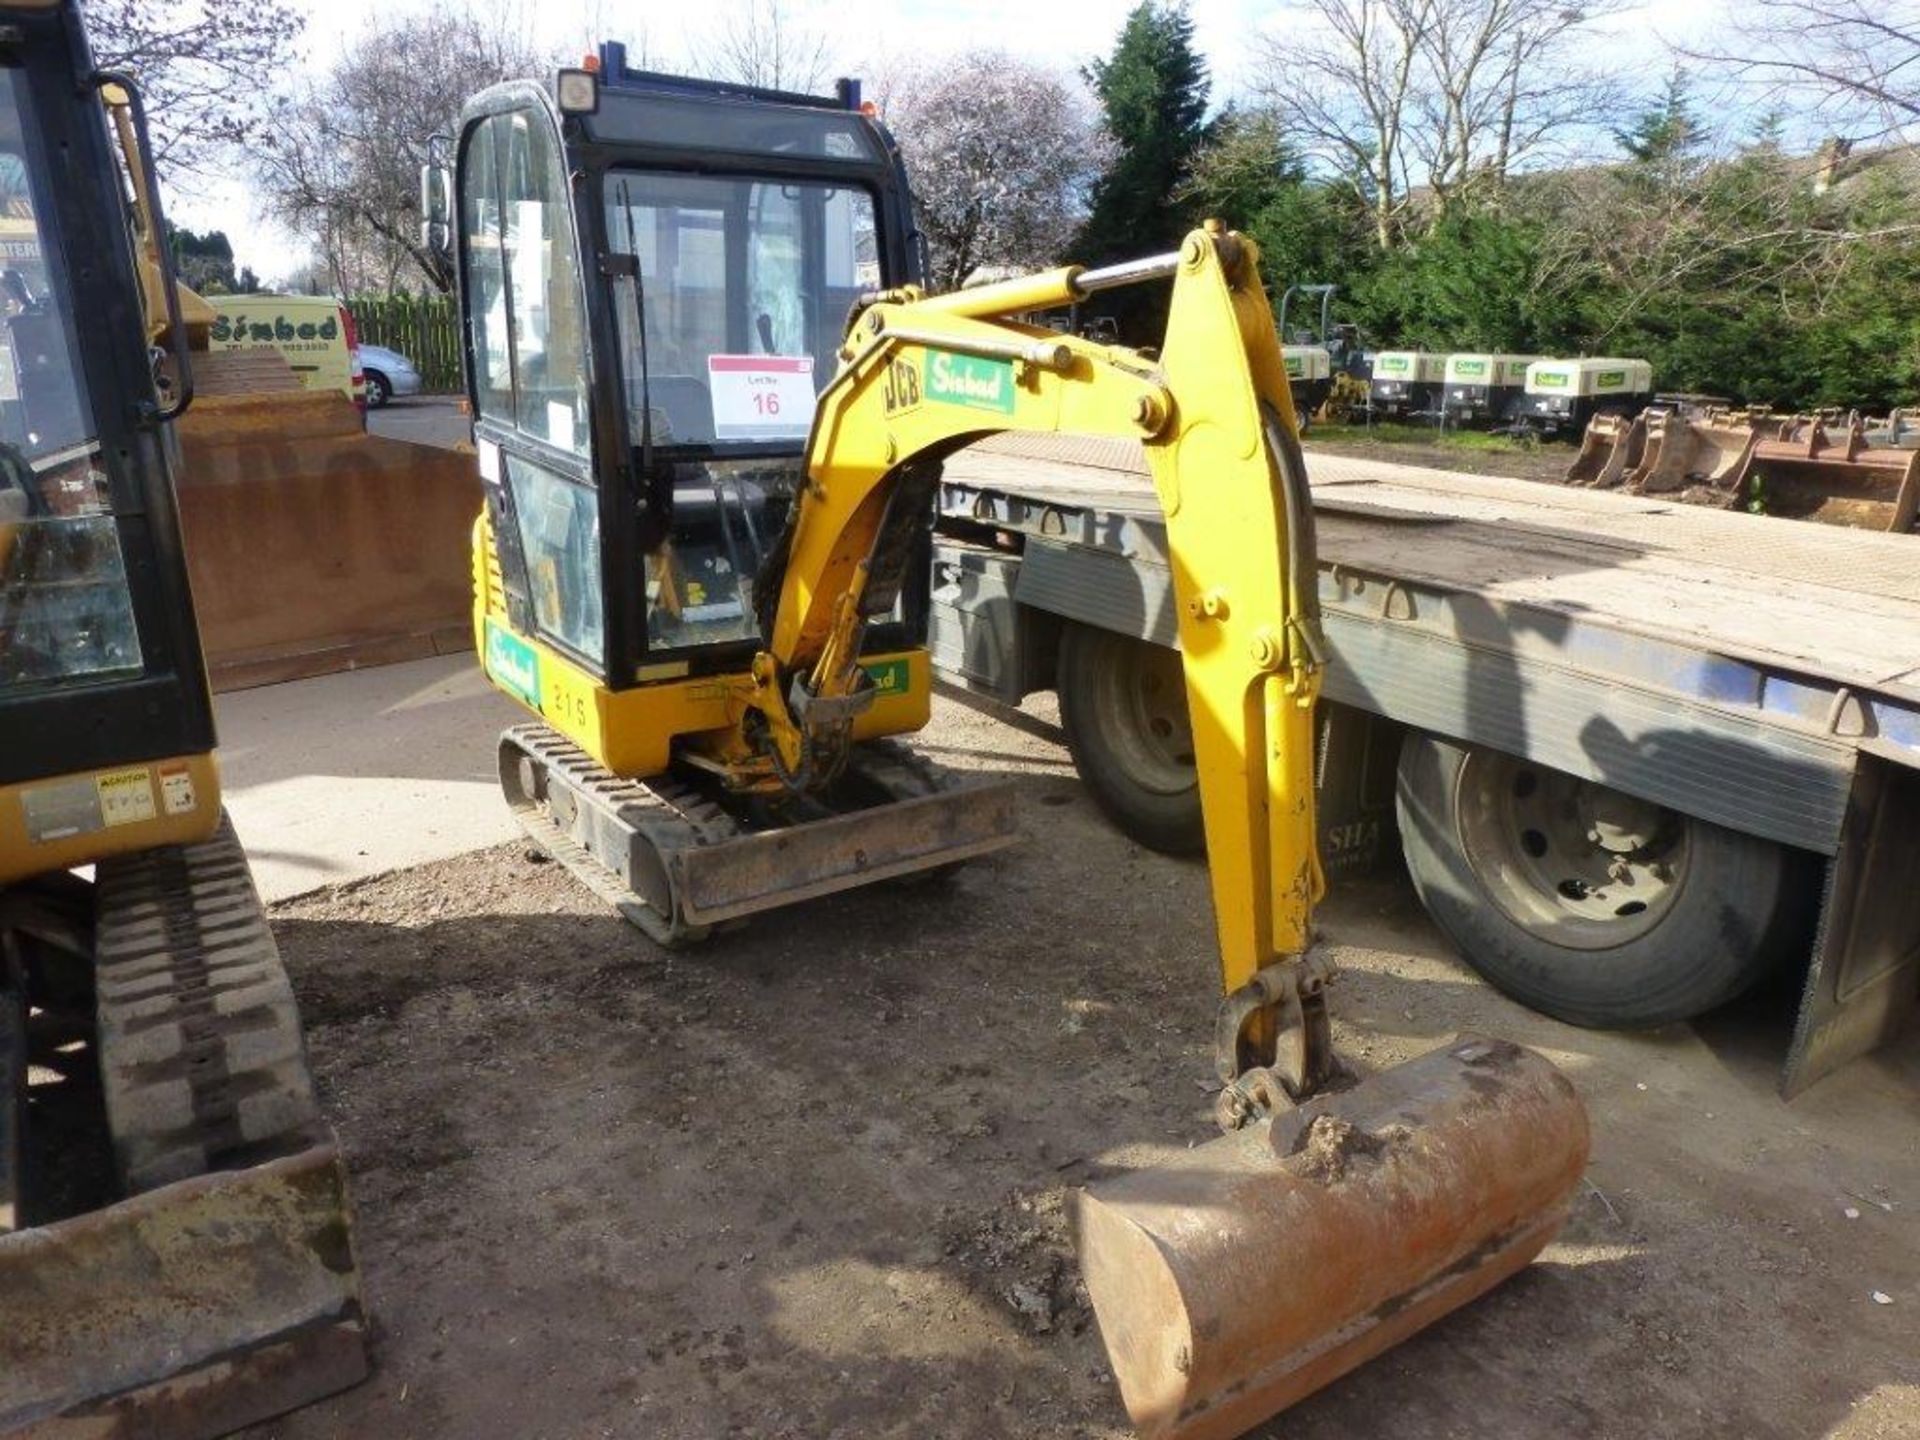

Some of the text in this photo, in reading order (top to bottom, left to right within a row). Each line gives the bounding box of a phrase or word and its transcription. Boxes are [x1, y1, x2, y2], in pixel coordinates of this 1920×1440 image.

[885, 360, 919, 412] JCB
[931, 352, 1002, 401] Sinbad
[753, 392, 780, 415] 16
